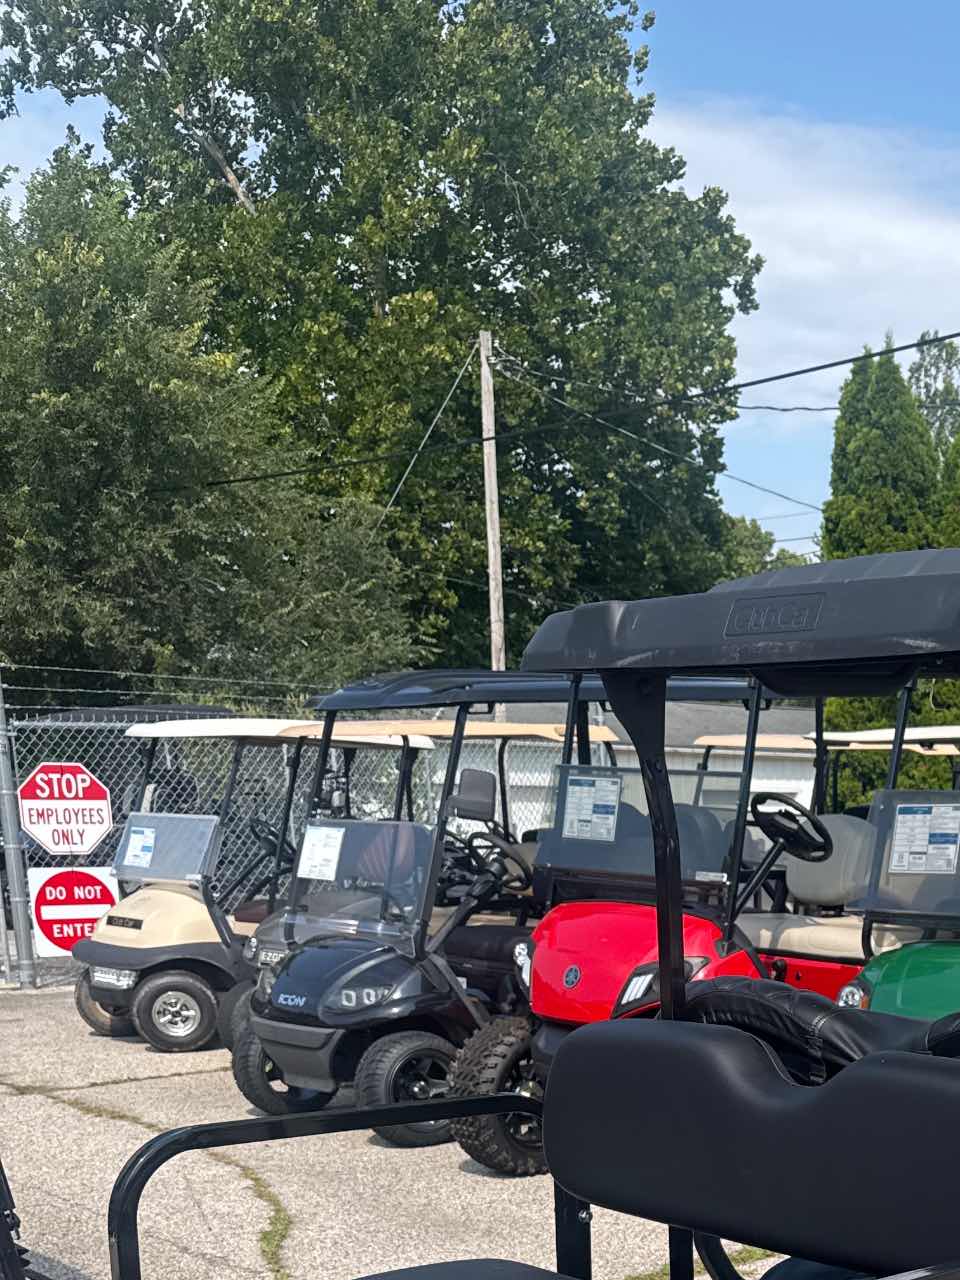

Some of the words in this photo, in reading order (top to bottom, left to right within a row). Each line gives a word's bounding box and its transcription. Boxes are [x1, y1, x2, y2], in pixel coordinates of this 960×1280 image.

[35, 772, 91, 799] STOP
[28, 807, 105, 825] EMPLOYEES
[52, 828, 86, 846] ONLY
[45, 886, 67, 900] DO
[73, 885, 102, 899] NOT
[52, 923, 97, 938] ENTE
[278, 993, 306, 1007] ICON
